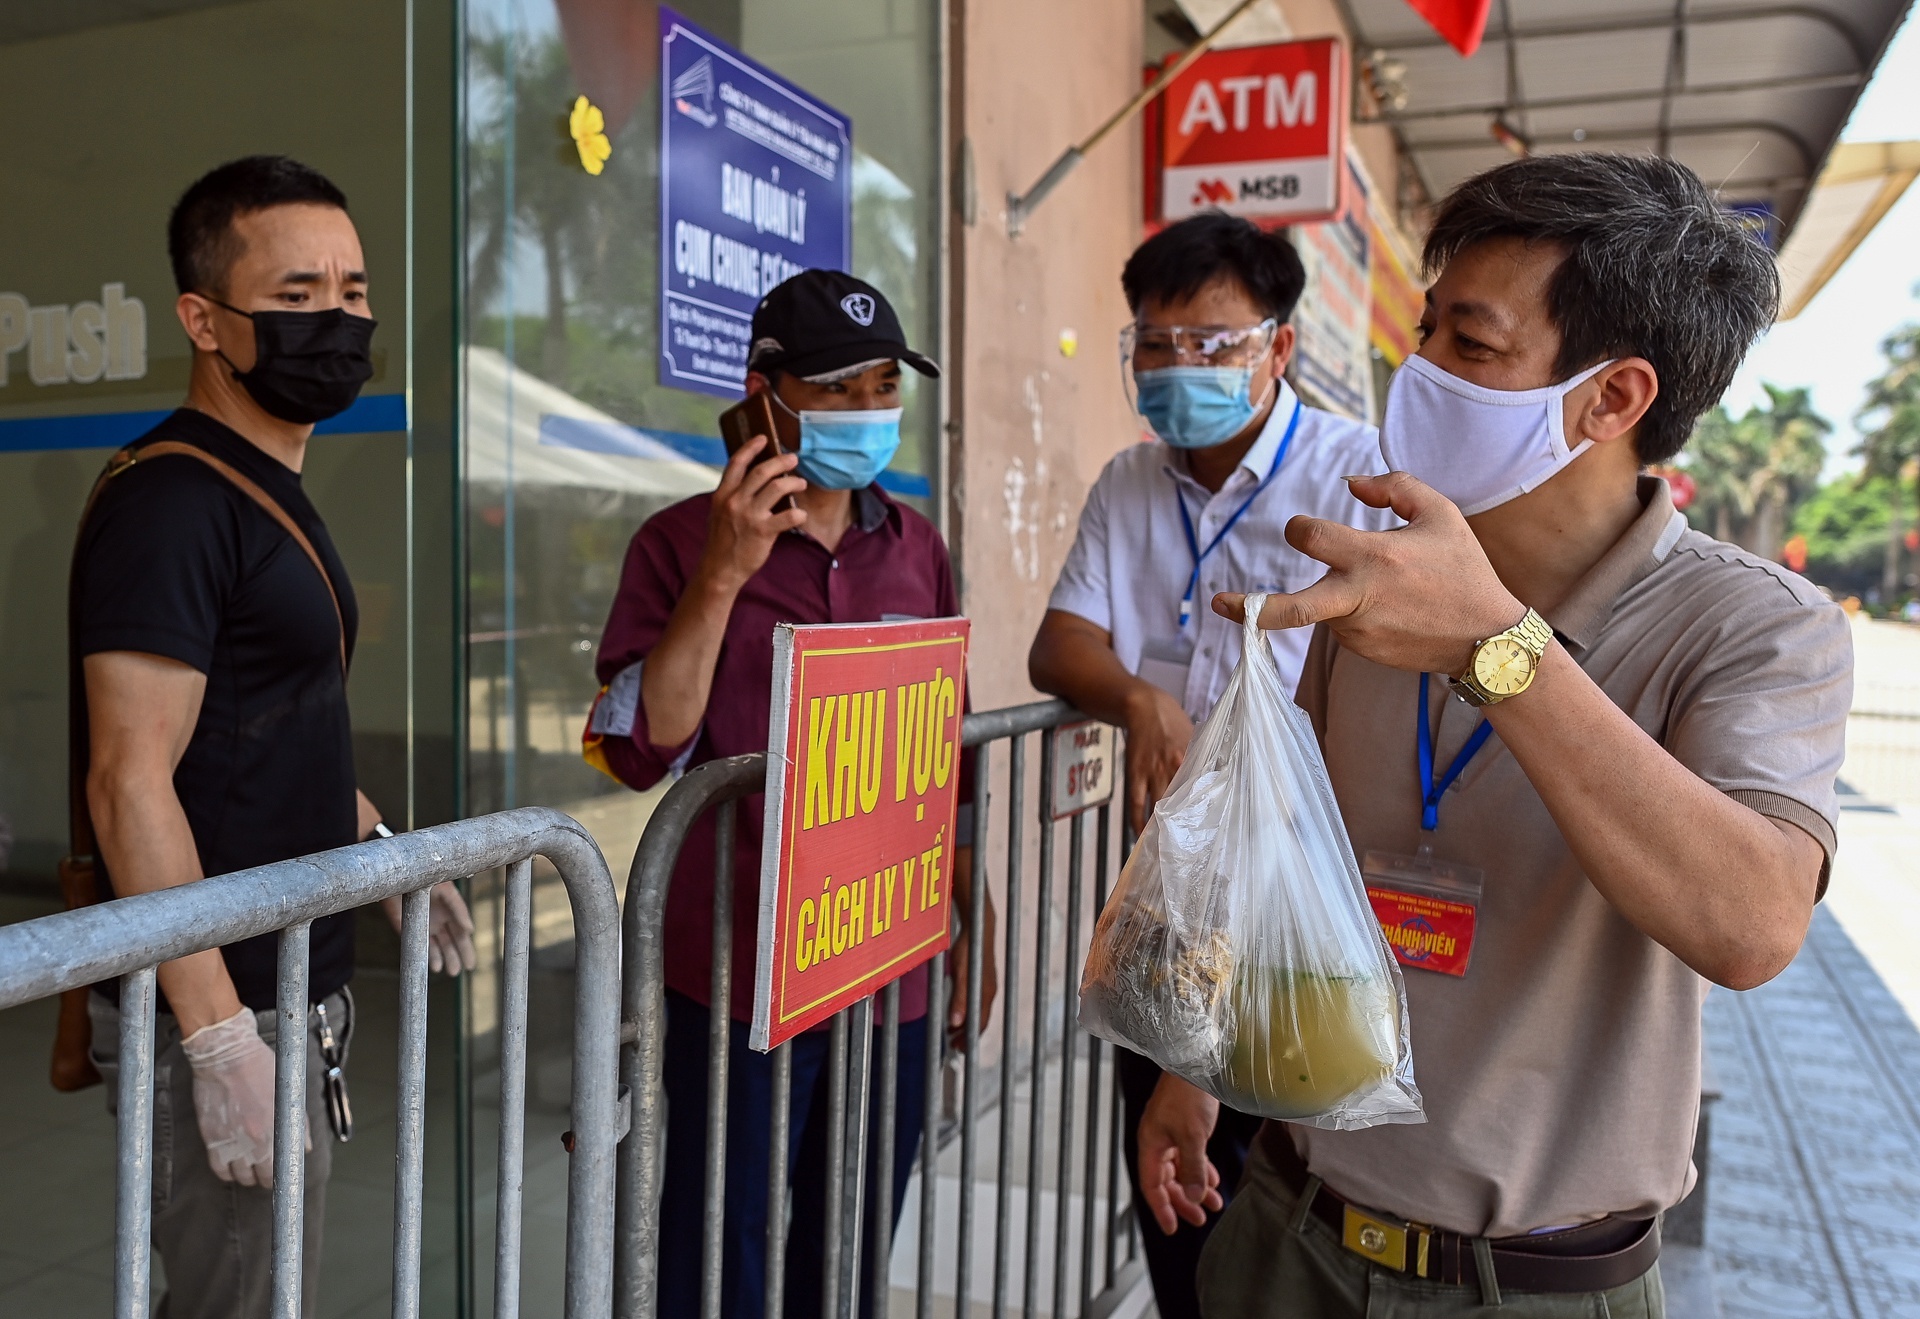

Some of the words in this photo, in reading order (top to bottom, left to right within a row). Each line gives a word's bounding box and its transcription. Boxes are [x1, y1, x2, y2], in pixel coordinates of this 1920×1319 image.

[1178, 70, 1318, 135] ATM
[753, 165, 790, 239] QUẢN
[790, 188, 806, 245] LÝ
[1239, 173, 1300, 202] MSB
[712, 233, 760, 298] CHUNG
[0, 282, 148, 387] Push
[802, 688, 887, 831] KHU
[895, 667, 956, 822] VỰC
[1068, 757, 1102, 796] STOP
[794, 875, 864, 973] CÁCH
[871, 864, 898, 939] LY
[903, 858, 917, 922] Y
[919, 824, 946, 913] TẾ
[1381, 922, 1421, 950] HÀNH
[1424, 931, 1456, 956] VIÊN
